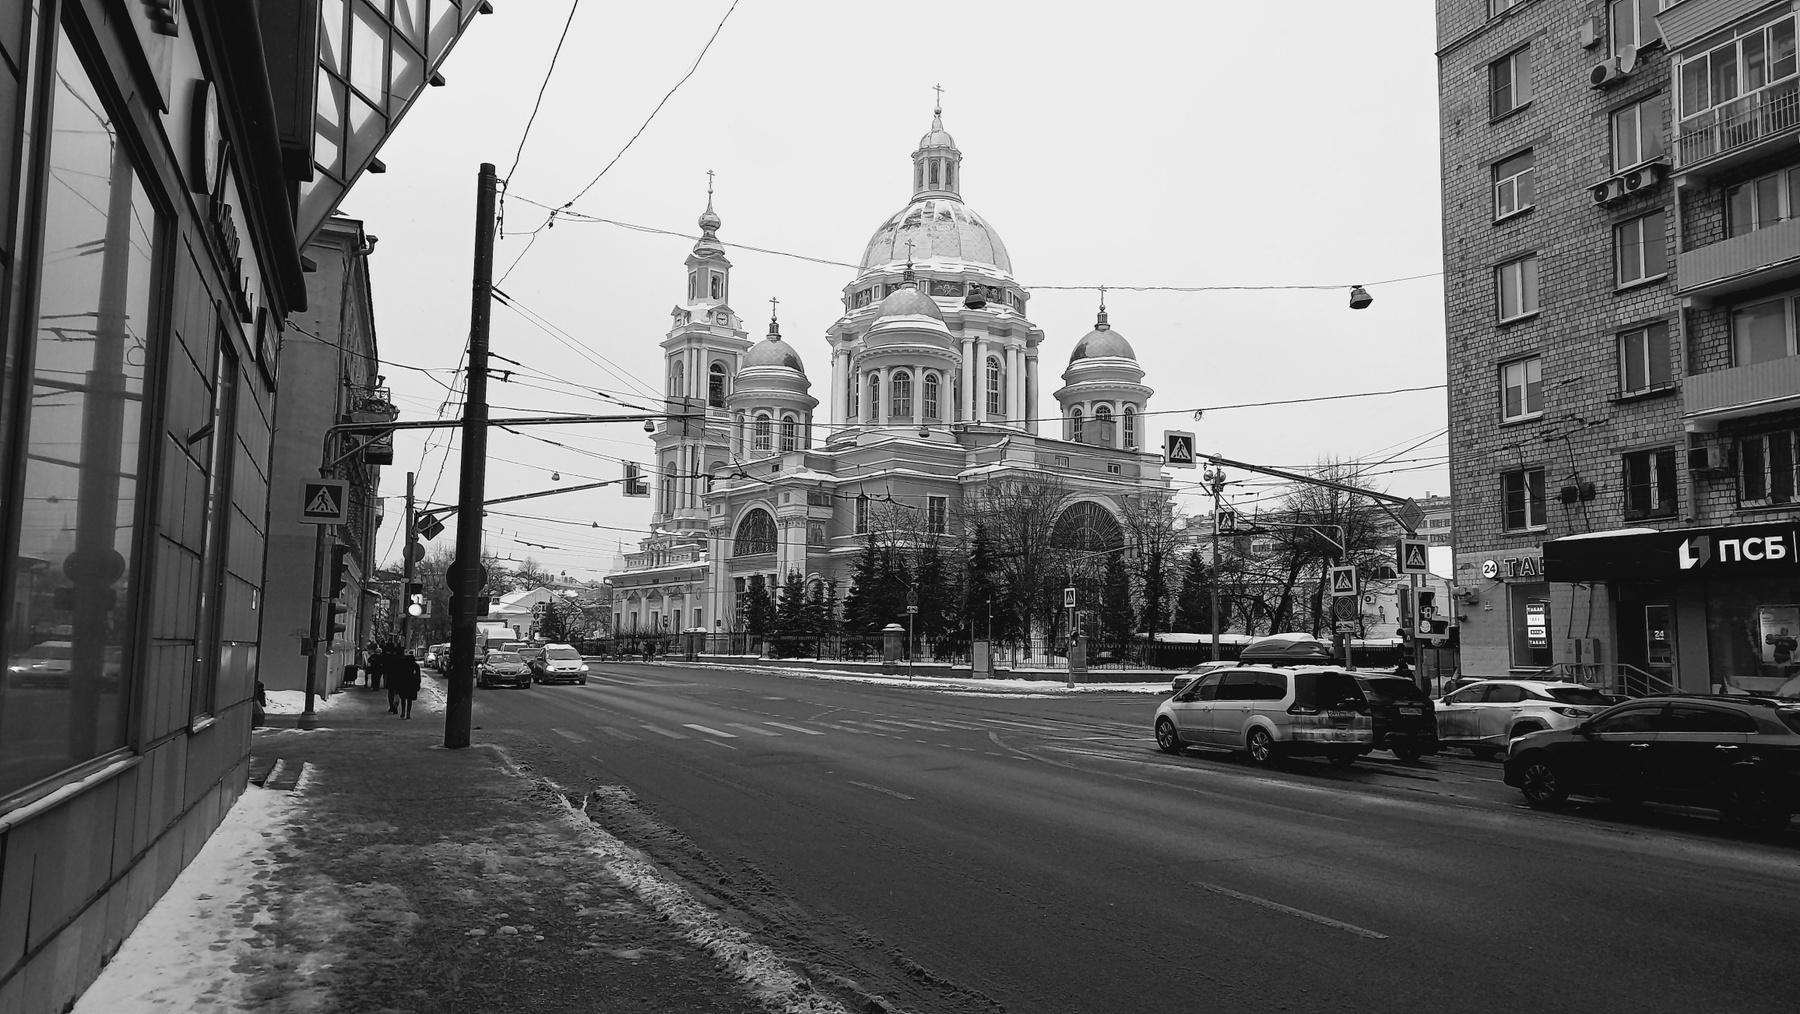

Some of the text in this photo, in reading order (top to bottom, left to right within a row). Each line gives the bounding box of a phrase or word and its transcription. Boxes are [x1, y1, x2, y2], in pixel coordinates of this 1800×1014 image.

[1719, 535, 1787, 562] ПСБ
[1484, 564, 1496, 574] 24
[1654, 630, 1664, 638] 24
